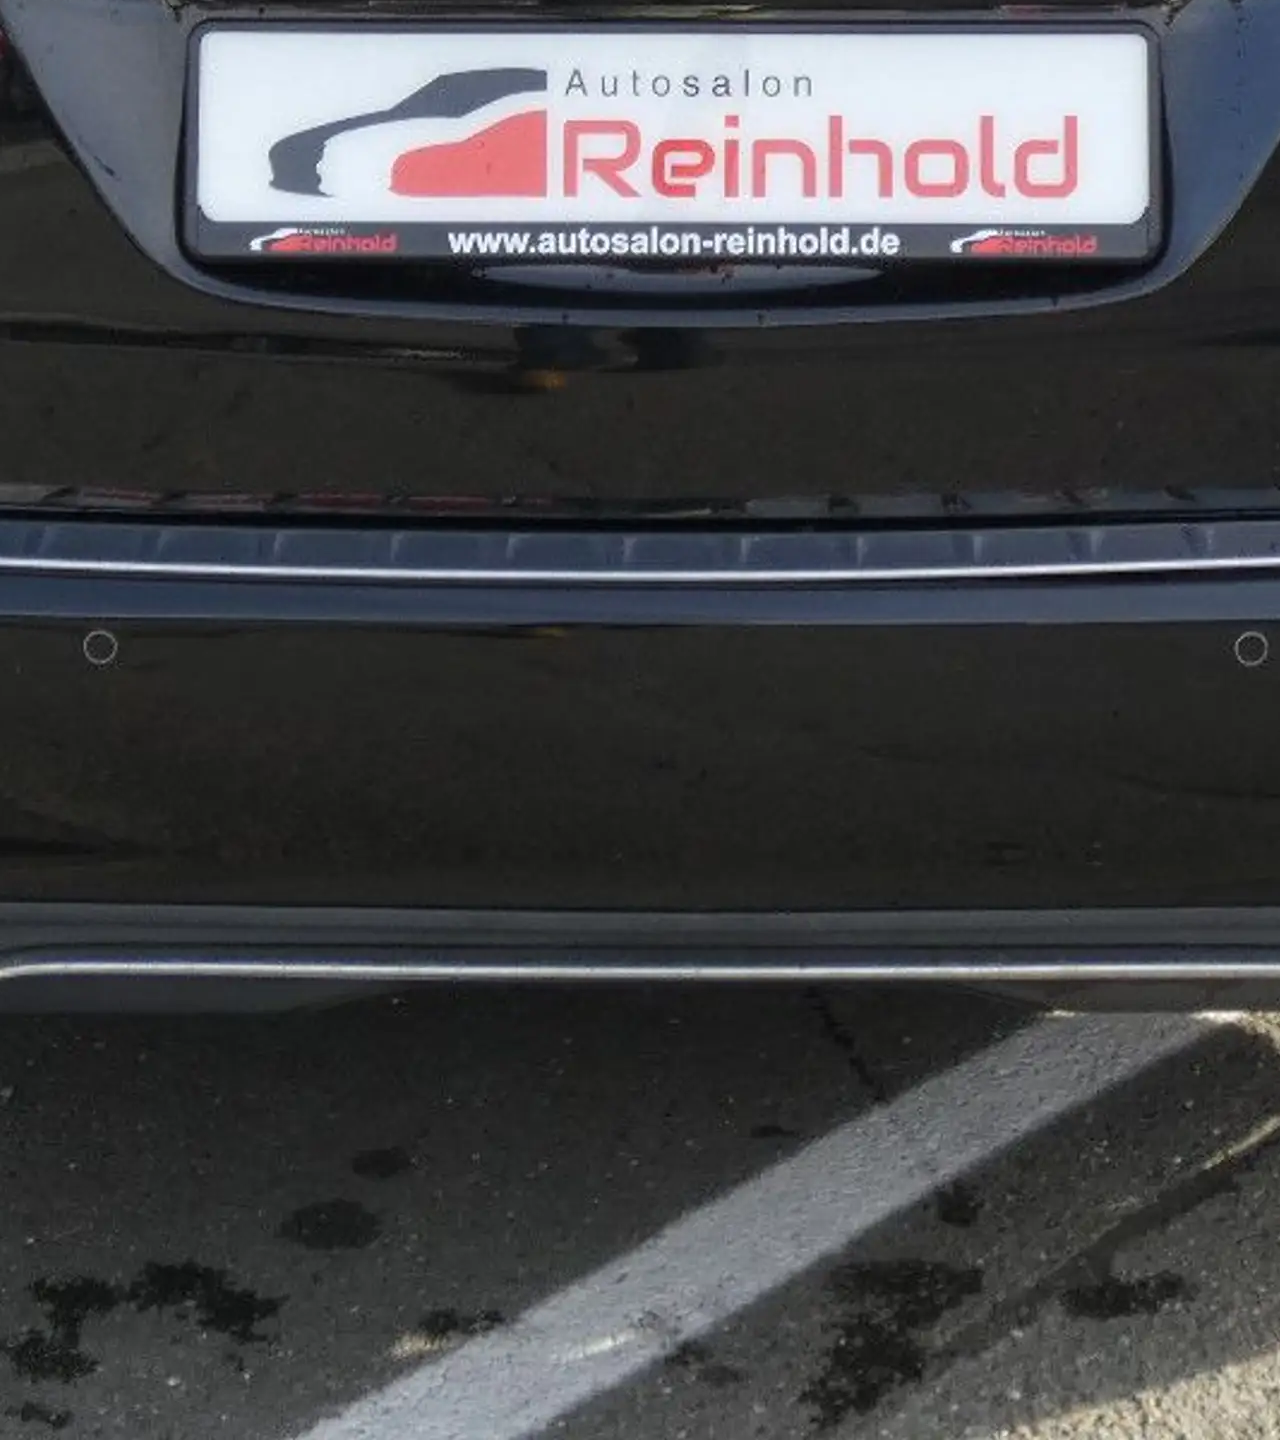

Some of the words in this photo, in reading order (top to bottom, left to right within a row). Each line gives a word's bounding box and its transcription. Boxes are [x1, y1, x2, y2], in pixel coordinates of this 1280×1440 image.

[565, 67, 815, 100] Autosalon
[563, 114, 1080, 197] Reinhold
[448, 227, 901, 258] www.autosalon-reinhold.de
